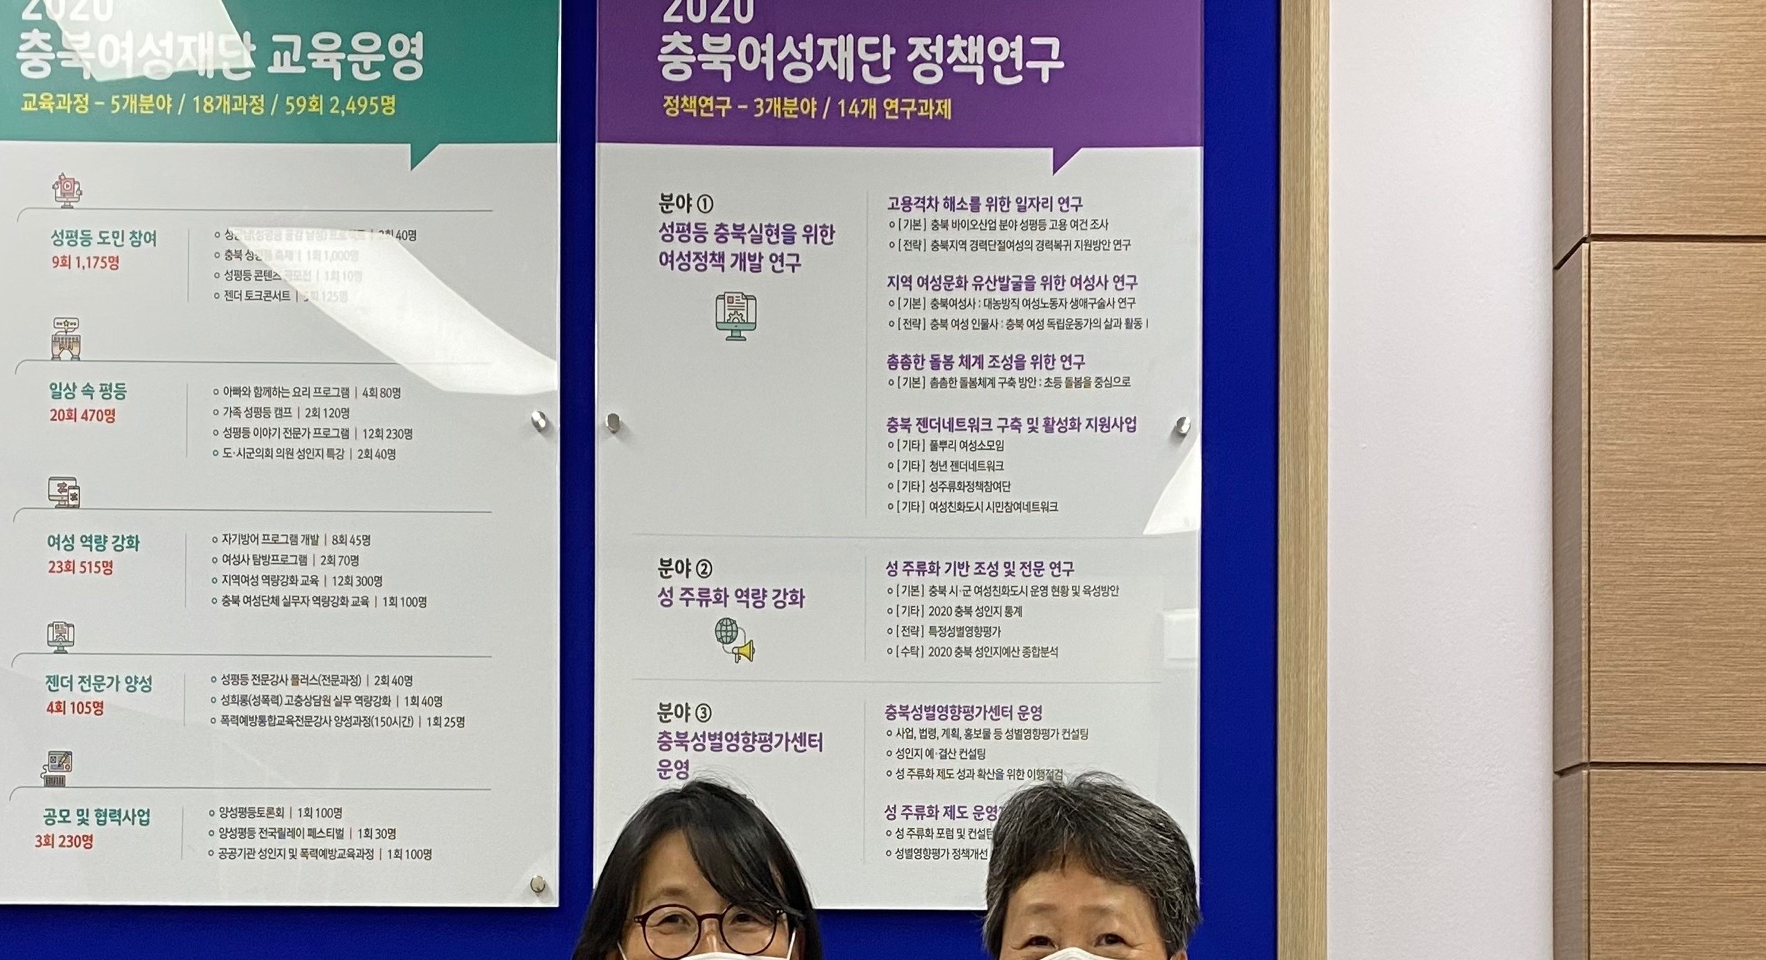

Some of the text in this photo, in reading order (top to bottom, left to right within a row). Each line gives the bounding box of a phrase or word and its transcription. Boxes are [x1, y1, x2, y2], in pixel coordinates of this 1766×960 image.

[16, 28, 426, 82] 충북여성재단 교육운영
[657, 30, 1065, 86] 충북여성재단 정책연구
[20, 91, 90, 114] 교육과정
[110, 93, 173, 115] 5개분야
[193, 93, 267, 117] 18개과정
[285, 94, 324, 116] 59회
[329, 94, 397, 118] 2,495명
[662, 94, 733, 118] 정책연구
[753, 96, 818, 119] 3개분야
[837, 97, 878, 120] 14개
[882, 97, 952, 121] 연구과제
[658, 192, 693, 215] 분야
[887, 195, 1084, 214] 고용격차 해소를 위한 일자리 연구
[50, 228, 157, 248] 성평등 도민 참여
[658, 220, 836, 246] 성평등 충북실현을 위한
[51, 254, 120, 271] 9회 1,175명
[658, 249, 802, 274] 여성정책 개발 연구
[49, 381, 128, 401] 일상 속 평등
[49, 407, 116, 424] 20회 470명
[886, 415, 1137, 434] 충북 젠더네트워크 구축 및 활성화 지원사업
[928, 625, 1002, 639] 특정성별영향평가
[928, 645, 1059, 659] 2020 충북 성인지예산 종합분석
[656, 701, 692, 724] 분야
[656, 729, 823, 754] 충북성별영향평가센터
[656, 758, 691, 781] 운영
[42, 807, 151, 827] 공모 및 협력사업
[34, 833, 94, 850] 3회 230명
[217, 847, 375, 861] 공공기관 성인지 및 폭력예방교육과정
